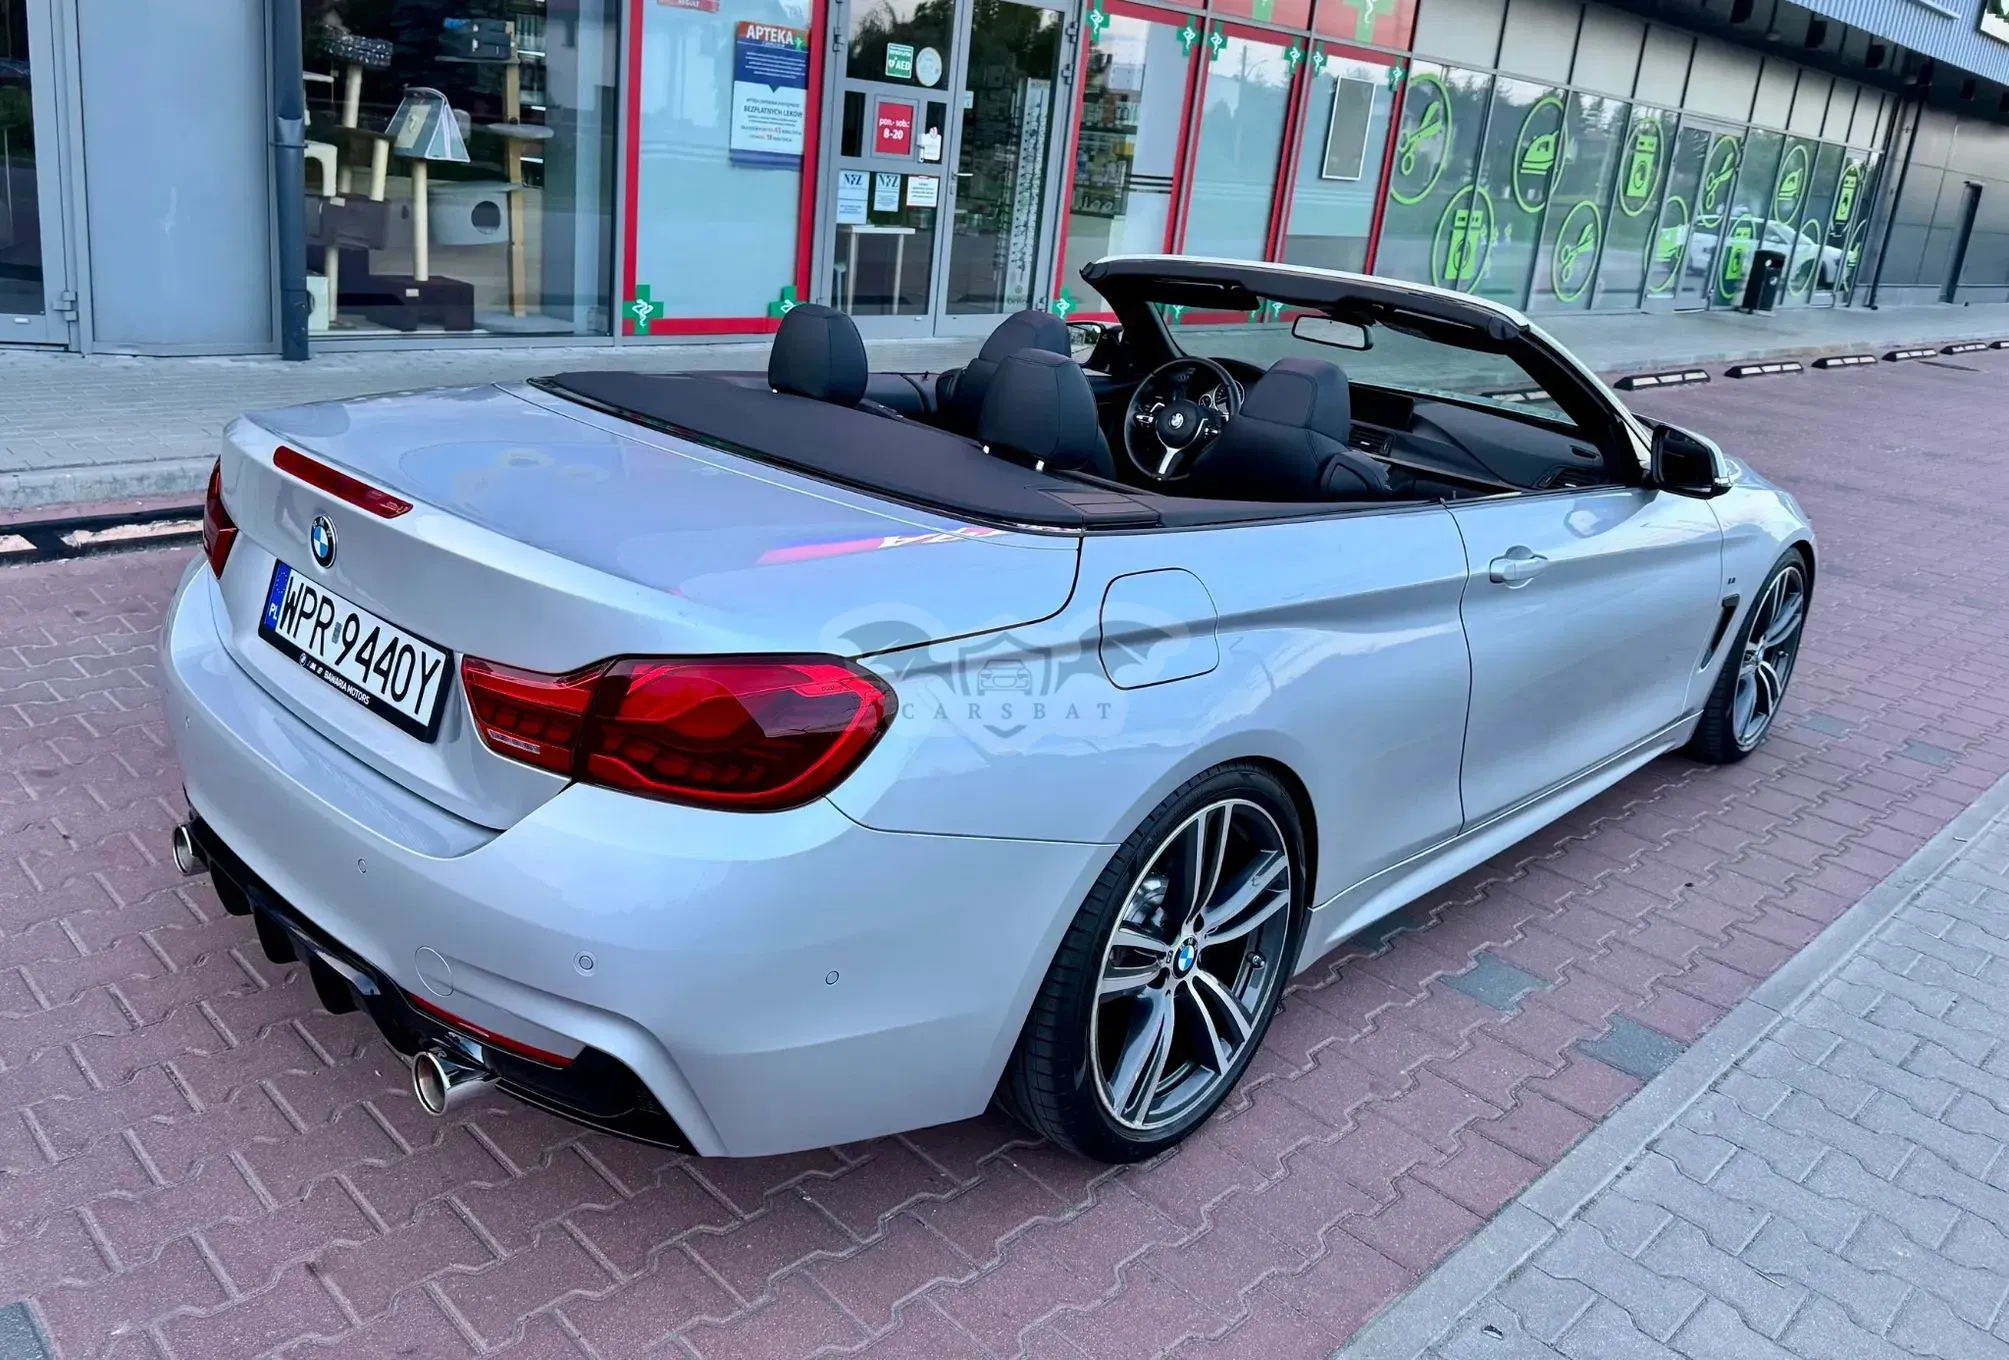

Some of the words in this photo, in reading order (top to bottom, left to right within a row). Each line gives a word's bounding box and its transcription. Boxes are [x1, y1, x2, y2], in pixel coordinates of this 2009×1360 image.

[746, 24, 794, 45] APTEKA
[895, 61, 911, 71] AED
[883, 128, 904, 140] 8-20
[268, 603, 279, 621] PL
[279, 576, 335, 657] WPR
[334, 612, 442, 715] 9440Y
[346, 684, 371, 705] MOTORS
